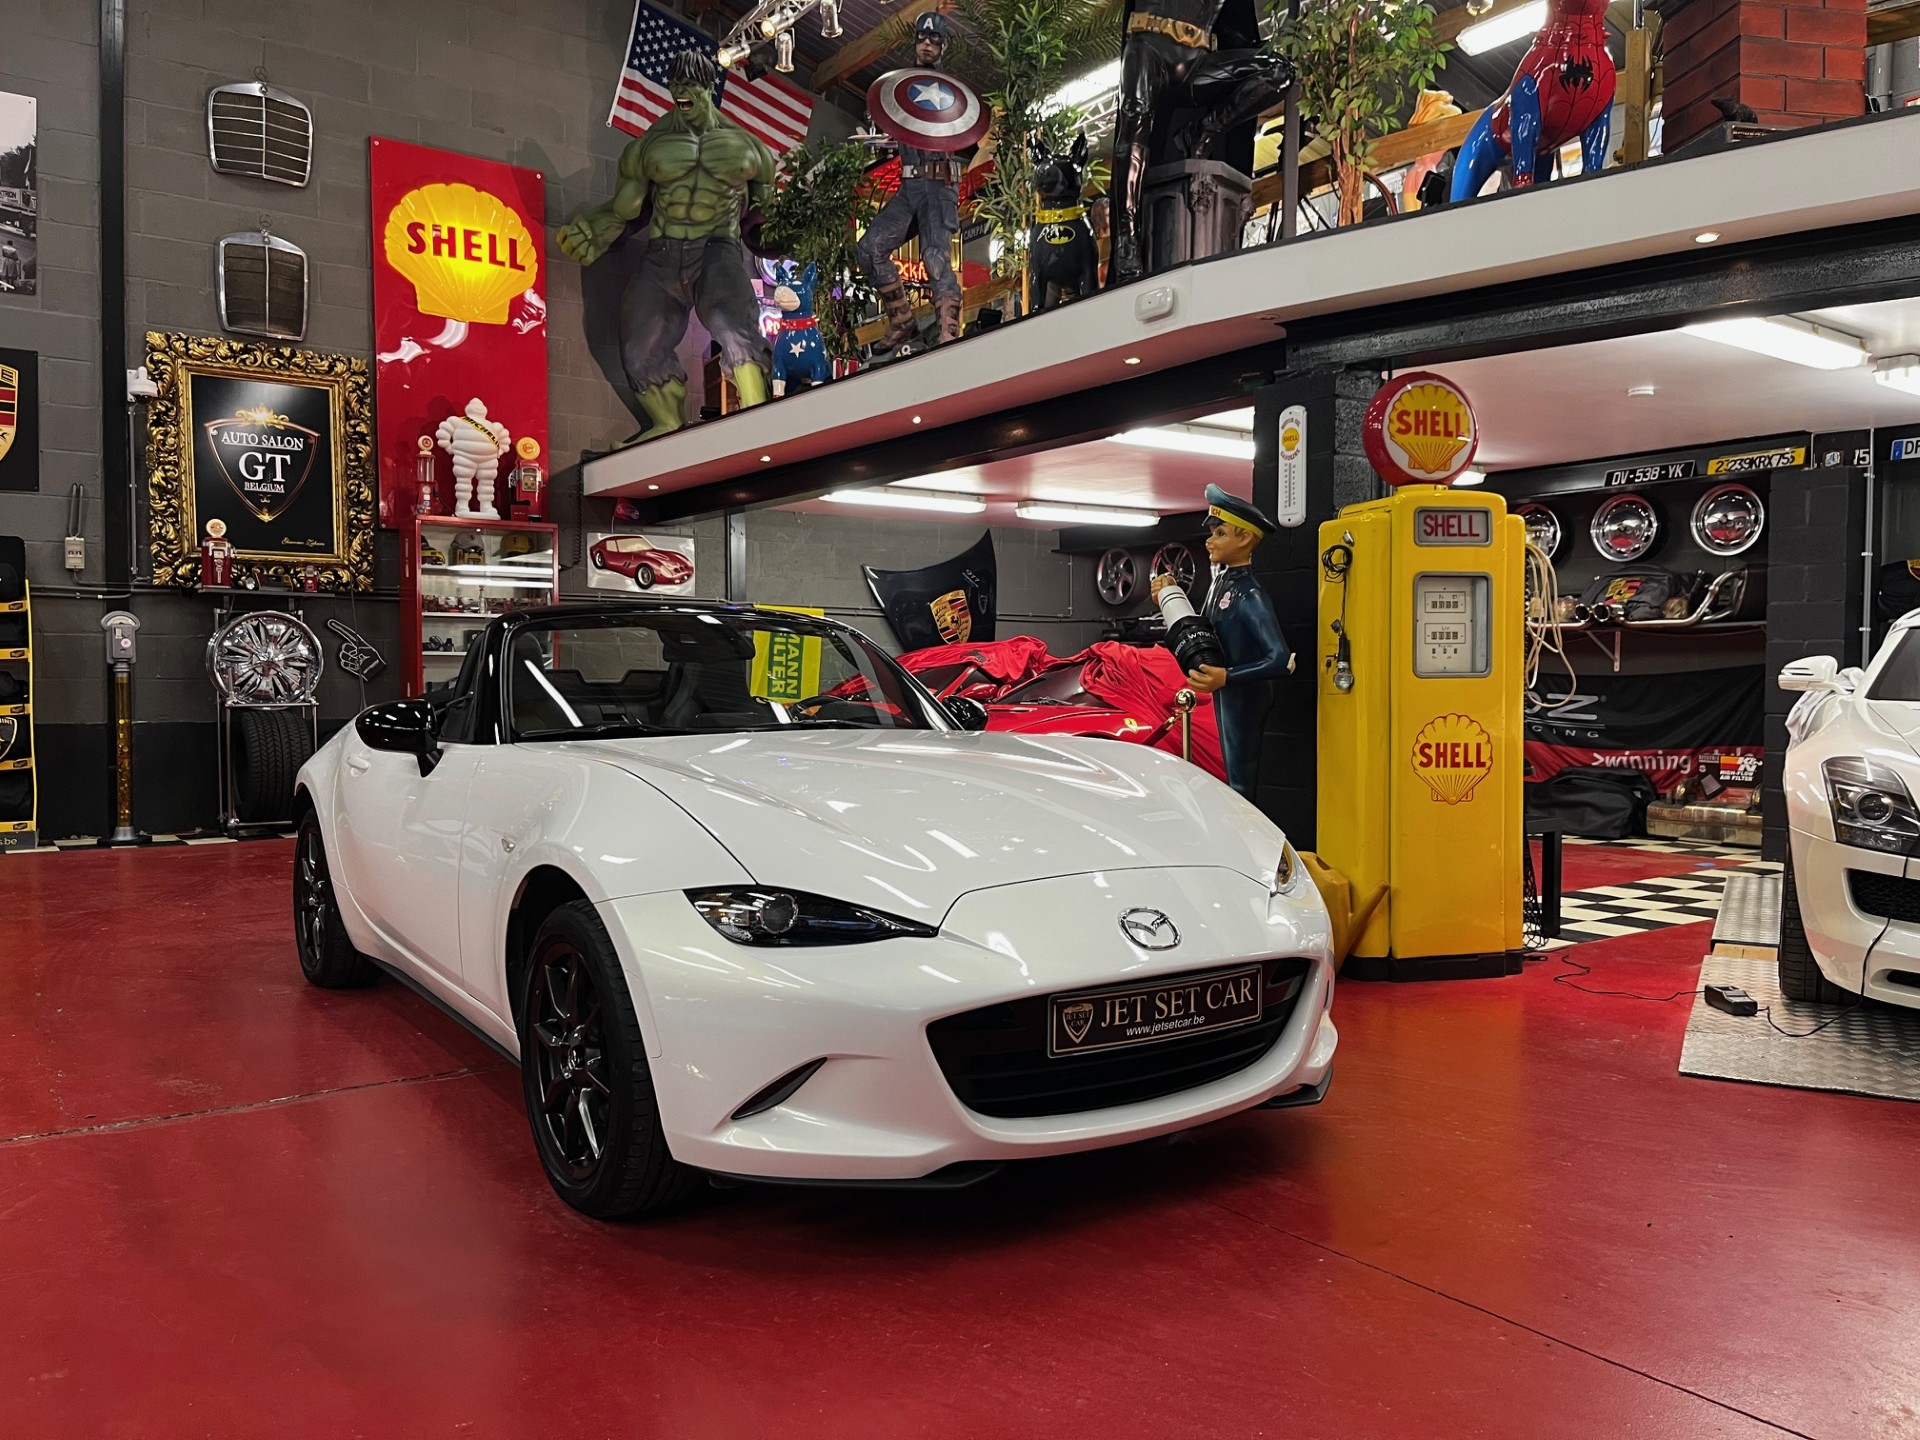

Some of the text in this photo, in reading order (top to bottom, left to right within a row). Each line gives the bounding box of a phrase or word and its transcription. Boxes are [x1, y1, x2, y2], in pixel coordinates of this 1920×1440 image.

[406, 221, 526, 272] SHELL
[1395, 409, 1462, 438] SHELL
[221, 430, 304, 450] AUTO SALON
[238, 451, 291, 482] GT
[1611, 464, 1685, 487] DV-538-YK
[244, 481, 285, 493] BELGIUM
[1422, 513, 1480, 538] SHELL
[771, 632, 787, 693] ILTER
[1418, 742, 1487, 769] SHELL
[1100, 976, 1254, 1028] JET SET CAR
[1125, 1015, 1206, 1037] www.jetsetcar.be
